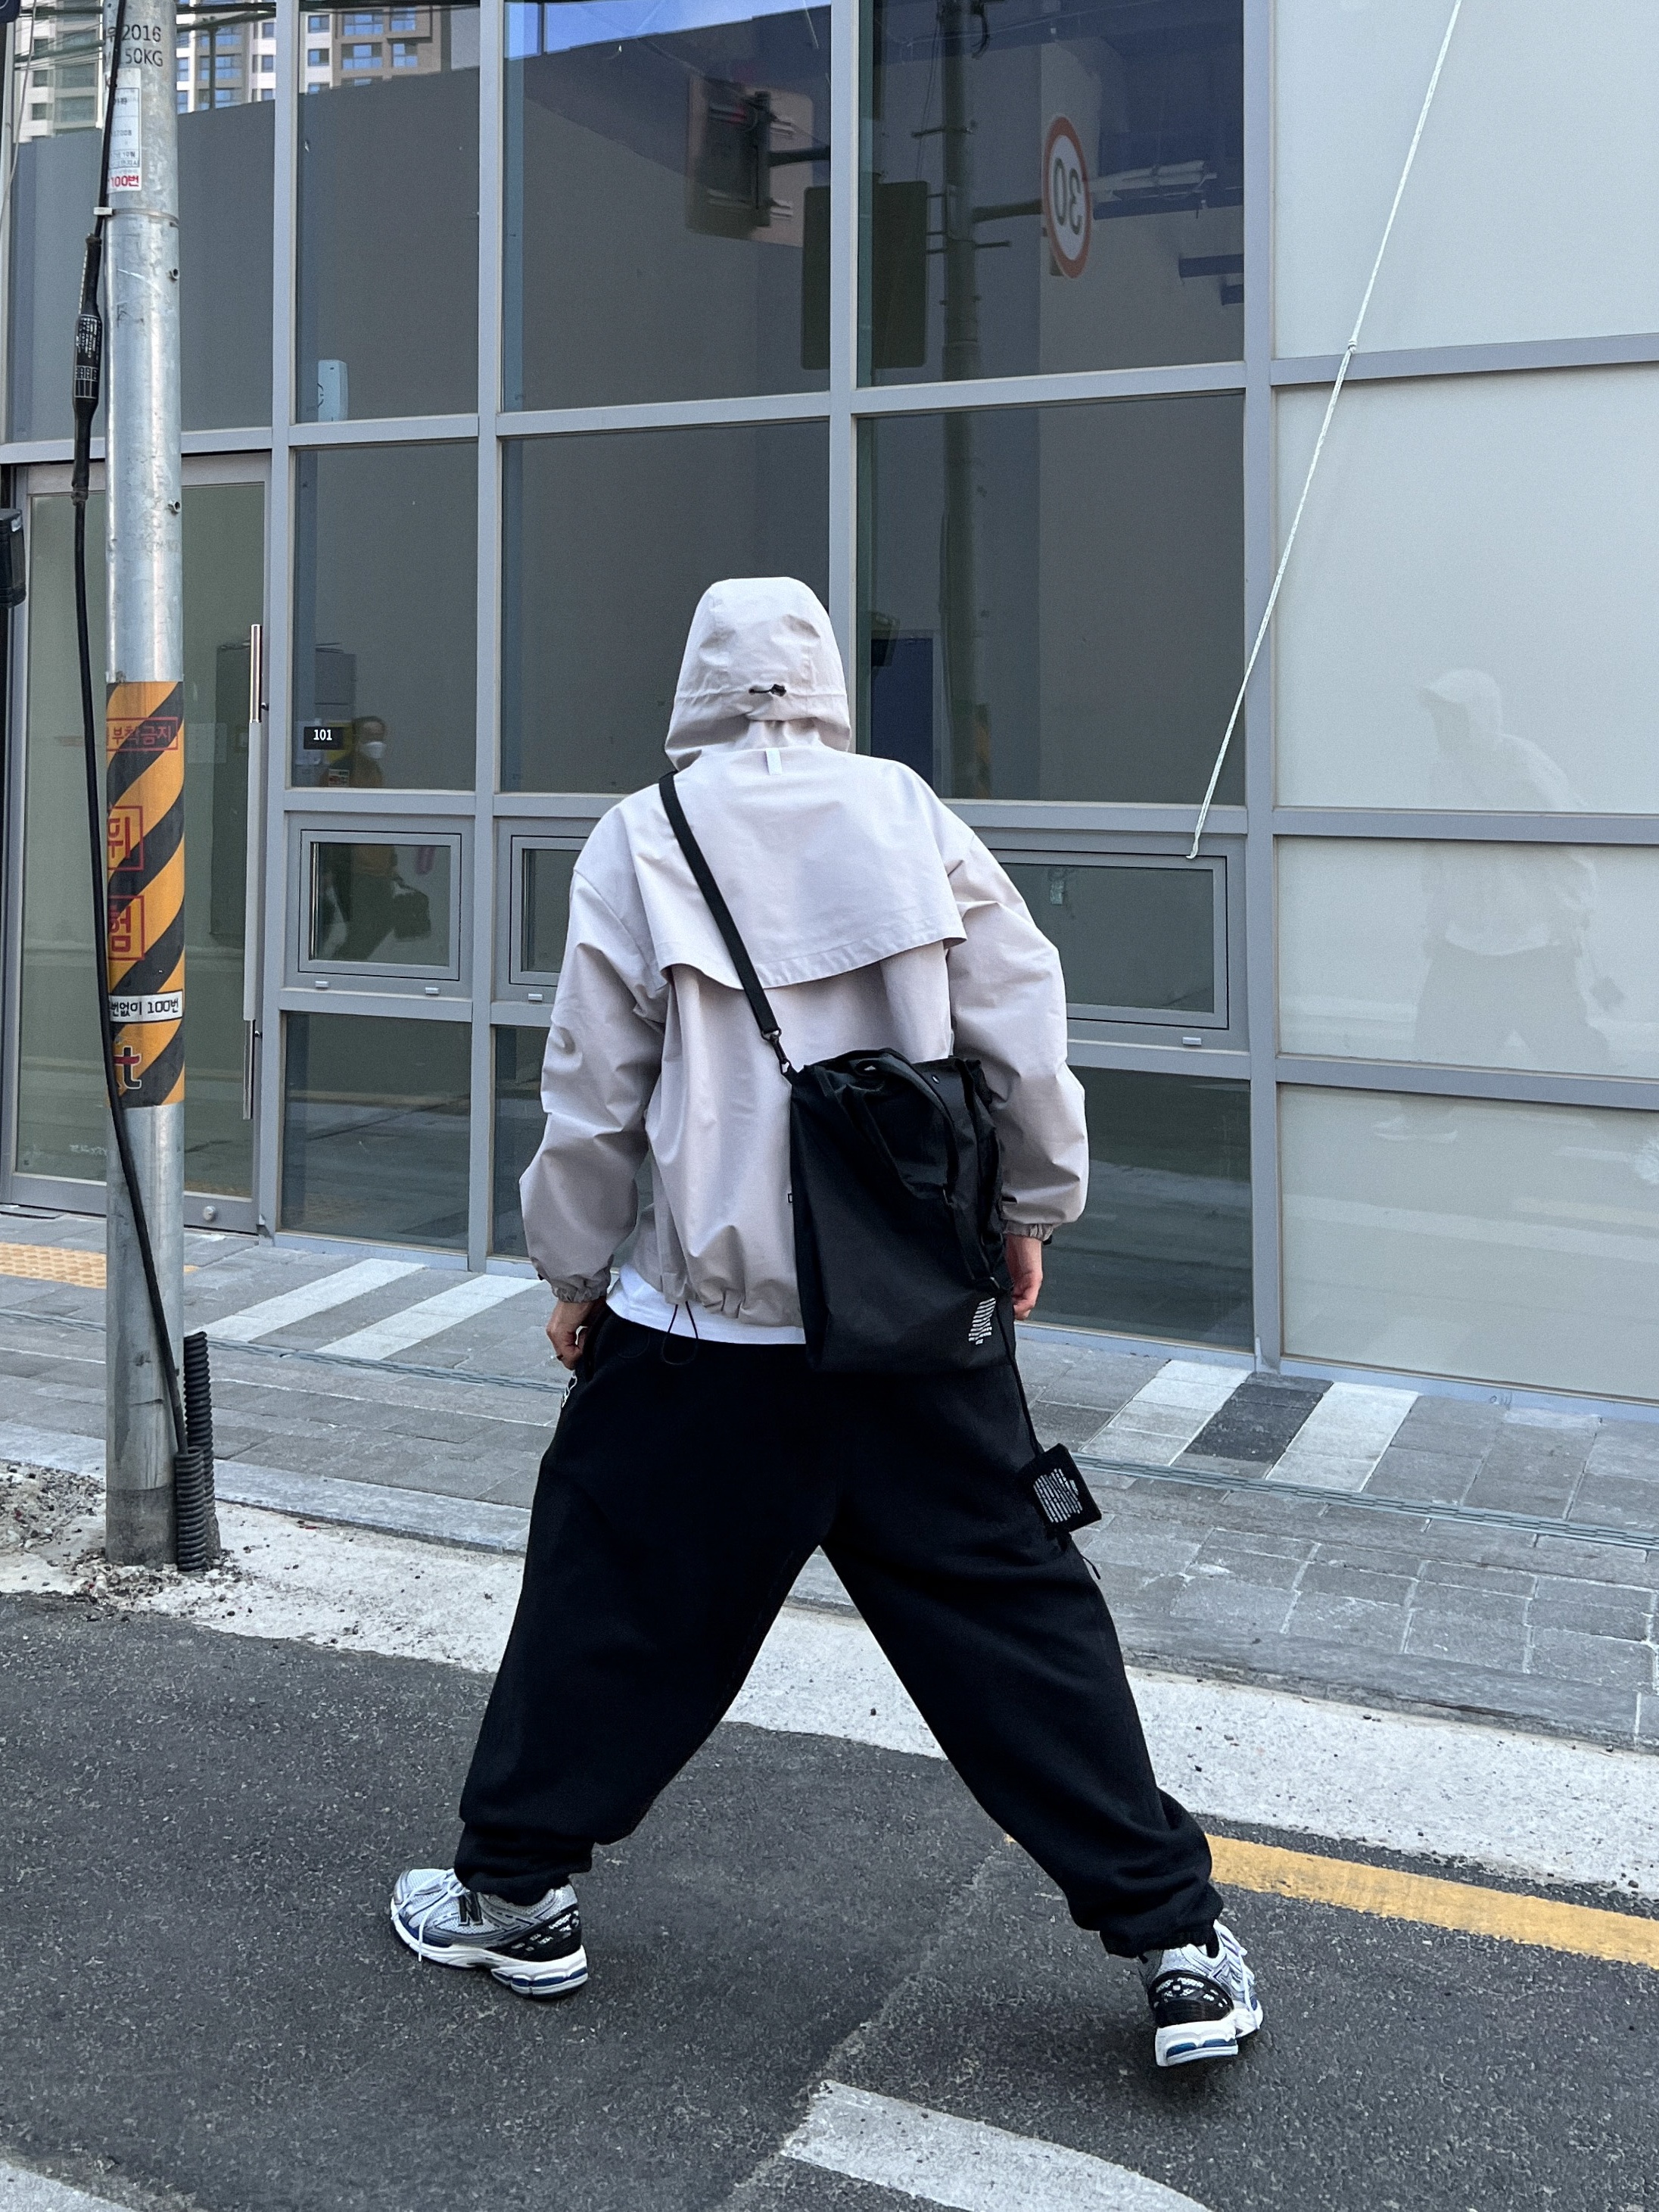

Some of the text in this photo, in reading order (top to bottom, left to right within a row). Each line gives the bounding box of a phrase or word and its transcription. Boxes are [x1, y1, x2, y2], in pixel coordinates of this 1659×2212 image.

[112, 725, 172, 746] 부착금지
[313, 728, 333, 741] 101
[147, 998, 179, 1014] 100번
[113, 1045, 142, 1089] t
